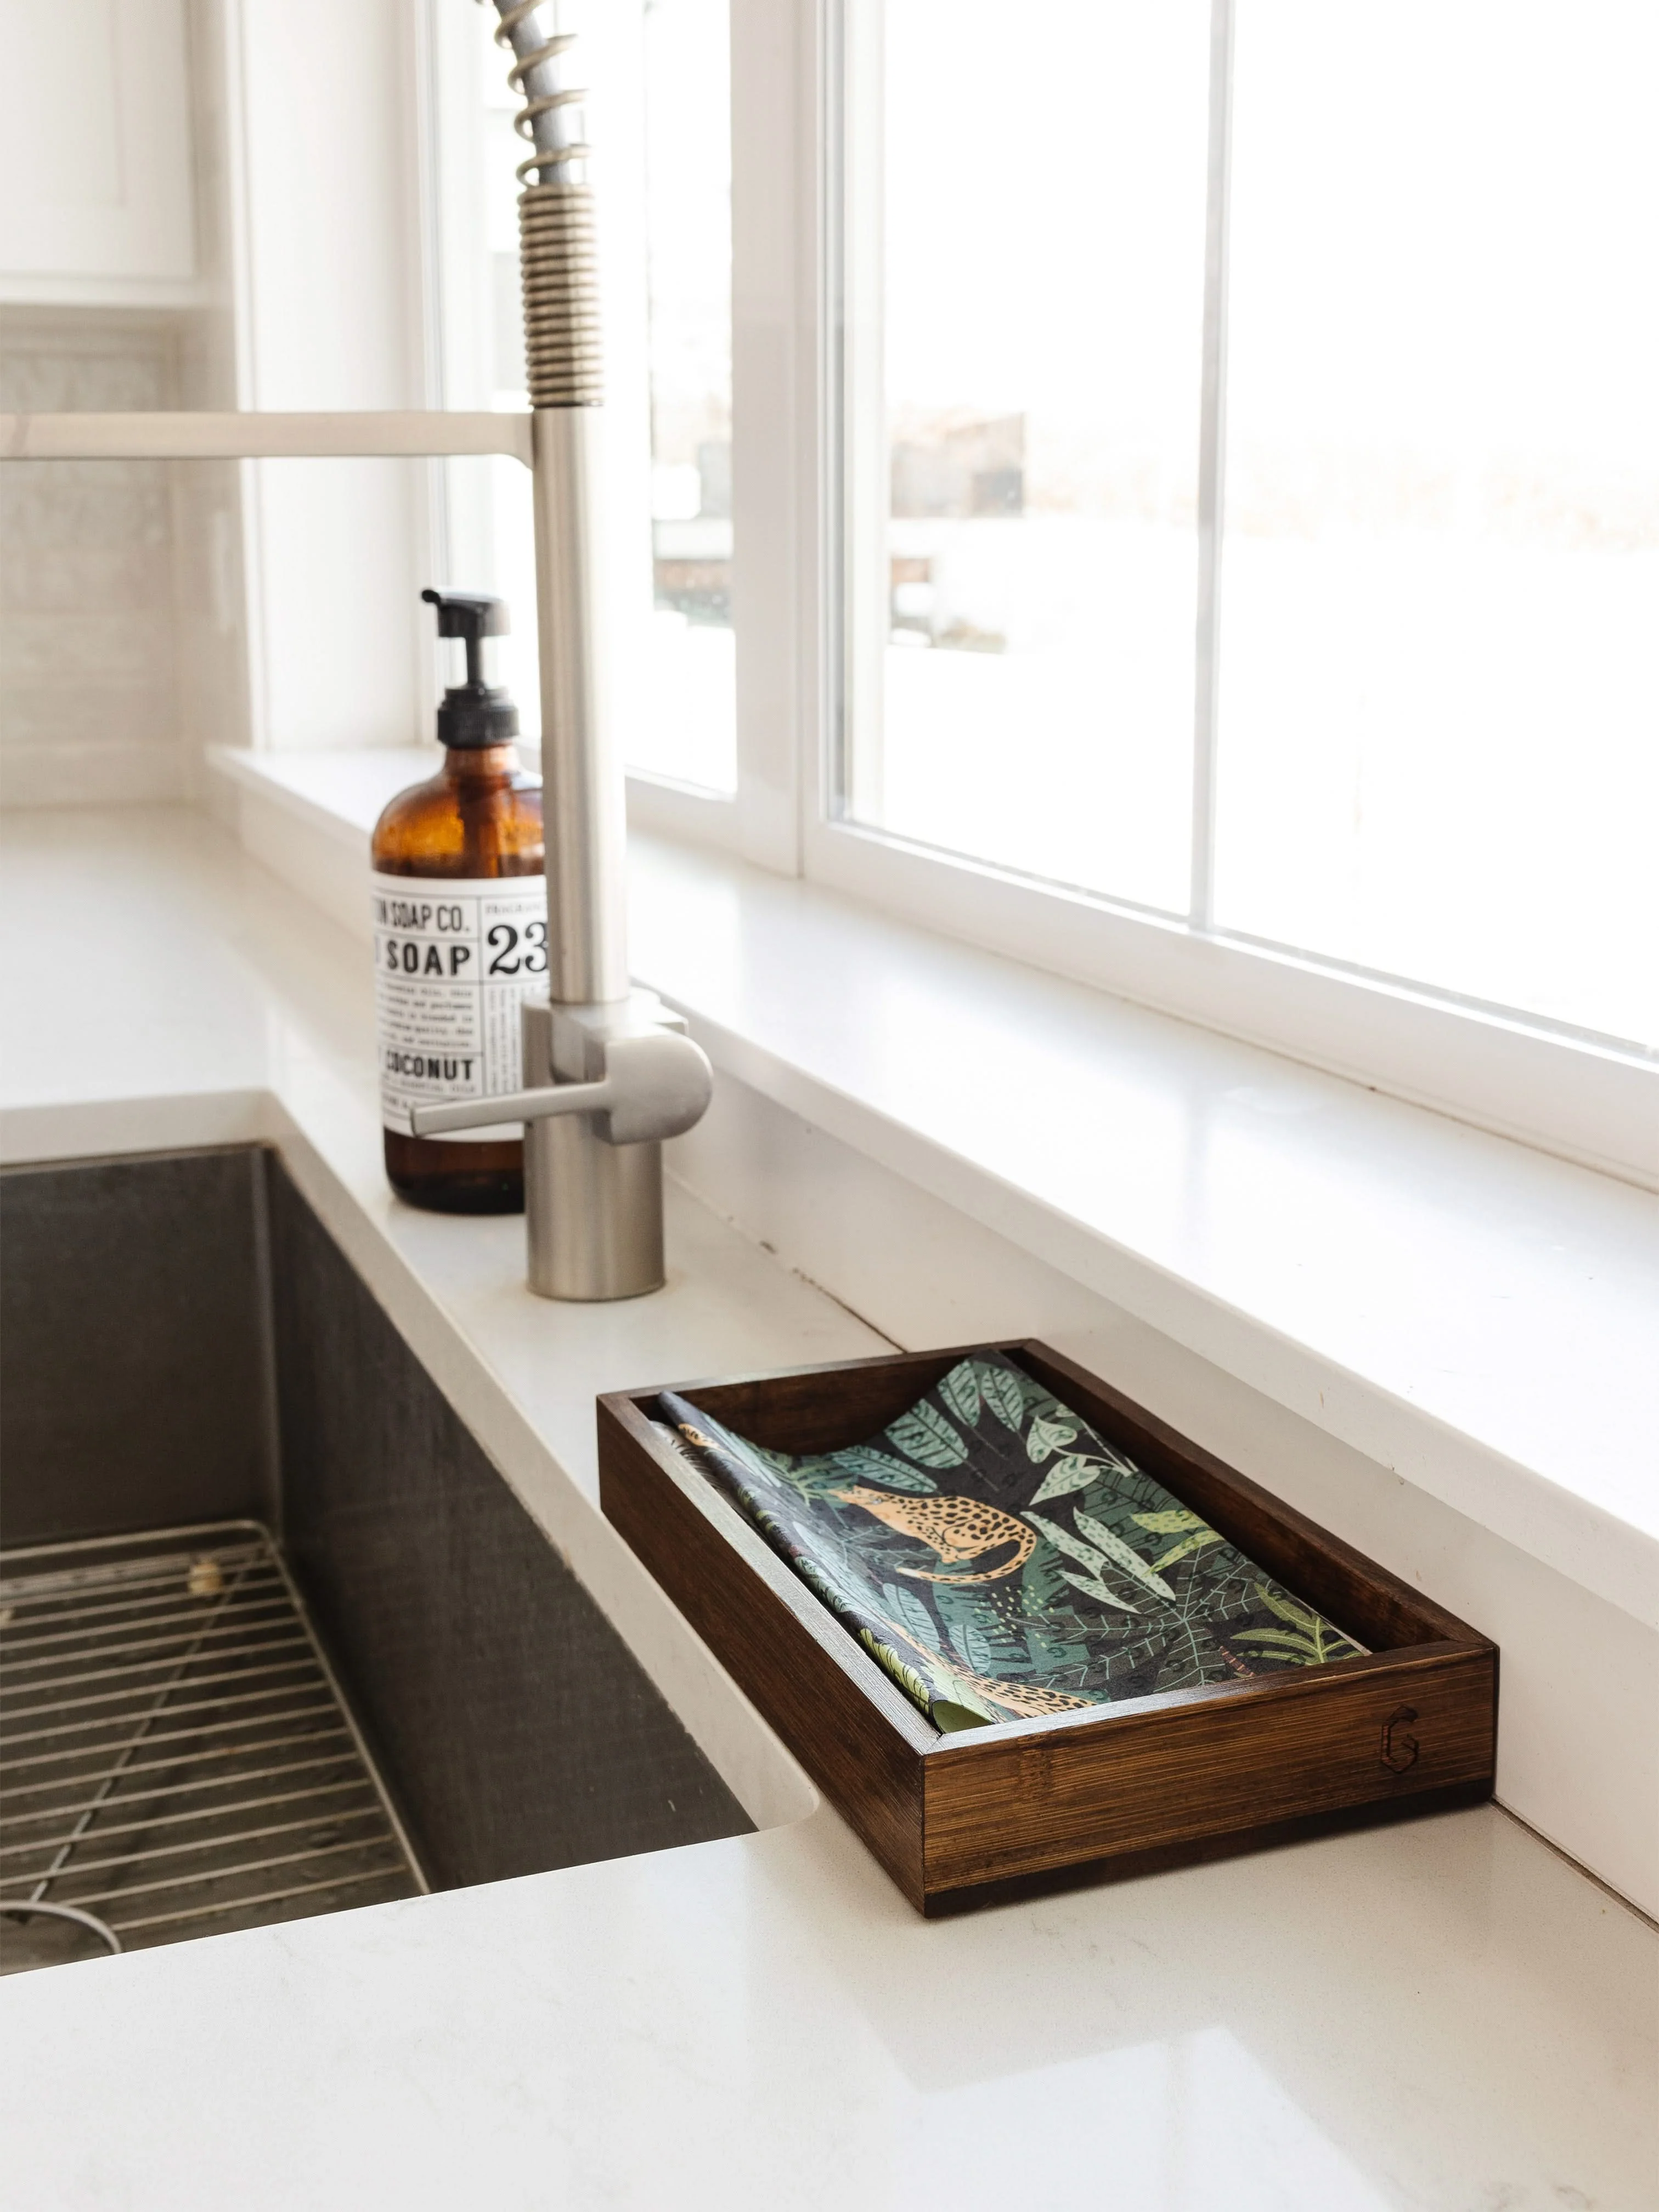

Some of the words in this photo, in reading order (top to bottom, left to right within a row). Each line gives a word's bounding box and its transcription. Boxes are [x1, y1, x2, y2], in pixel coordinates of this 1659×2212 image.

[391, 901, 431, 929] SOAP
[437, 905, 470, 932] CO.
[387, 940, 470, 975] SOAP
[488, 922, 548, 974] 23
[387, 1050, 473, 1081] COCONUT
